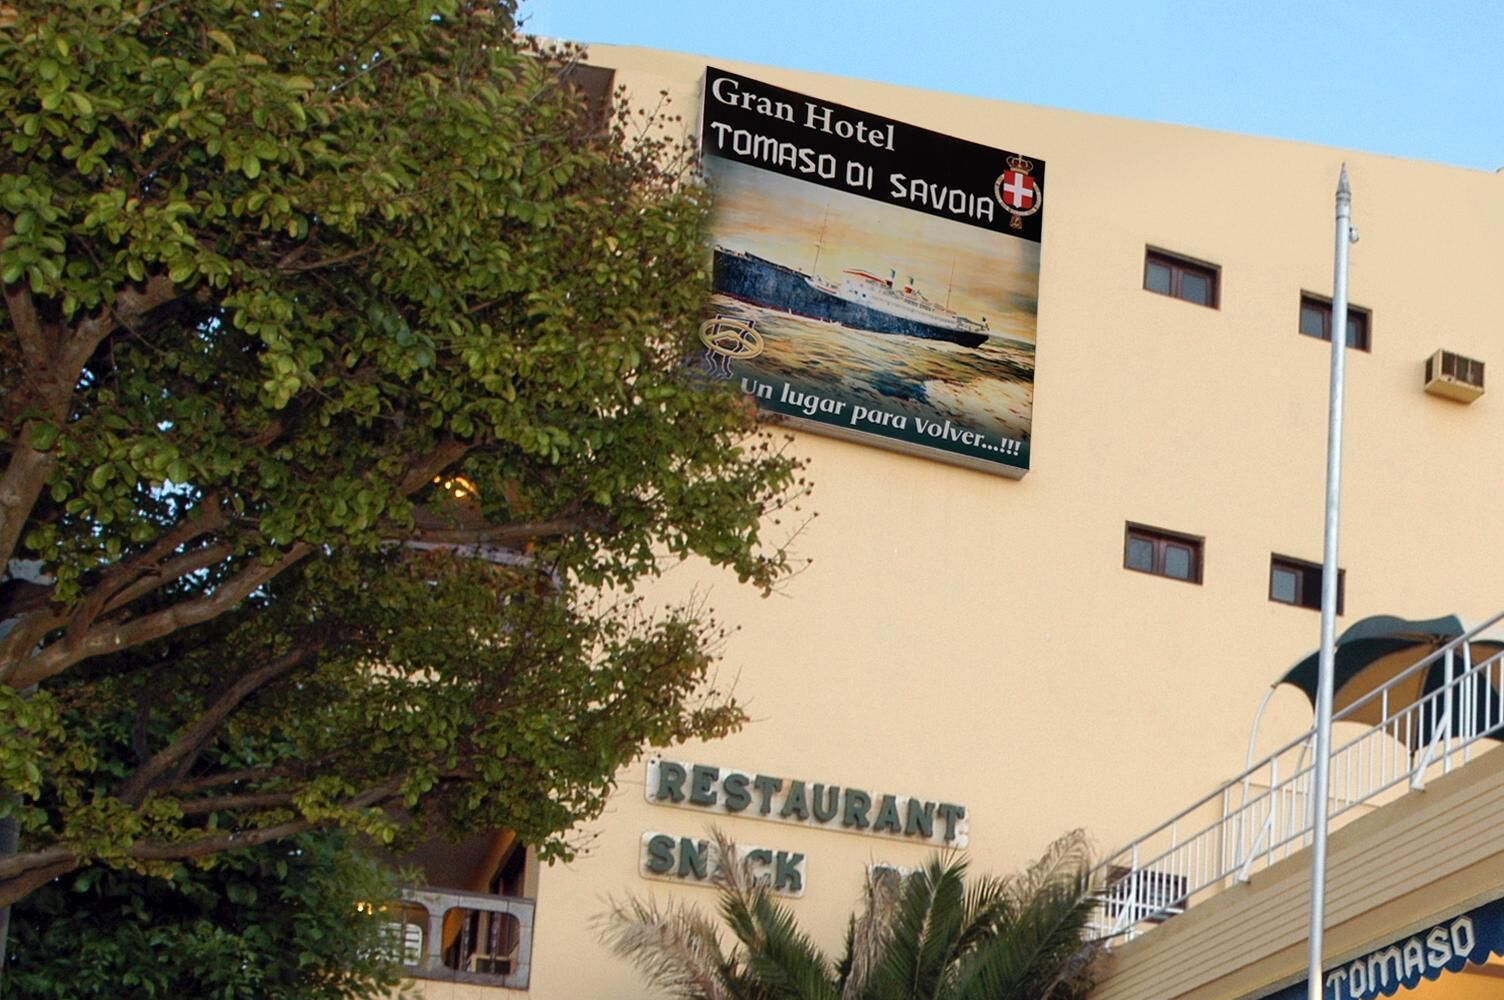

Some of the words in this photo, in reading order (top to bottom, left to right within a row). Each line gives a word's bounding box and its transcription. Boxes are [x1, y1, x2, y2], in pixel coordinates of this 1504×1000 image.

[711, 77, 794, 123] Gran
[804, 104, 895, 151] Hotel
[711, 121, 836, 180] TOMASO
[847, 160, 873, 190] DI
[890, 173, 994, 223] SAVOIA
[780, 382, 846, 416] lugar
[850, 403, 907, 430] para
[657, 760, 965, 841] RESTAURANT
[647, 835, 805, 892] SNCK
